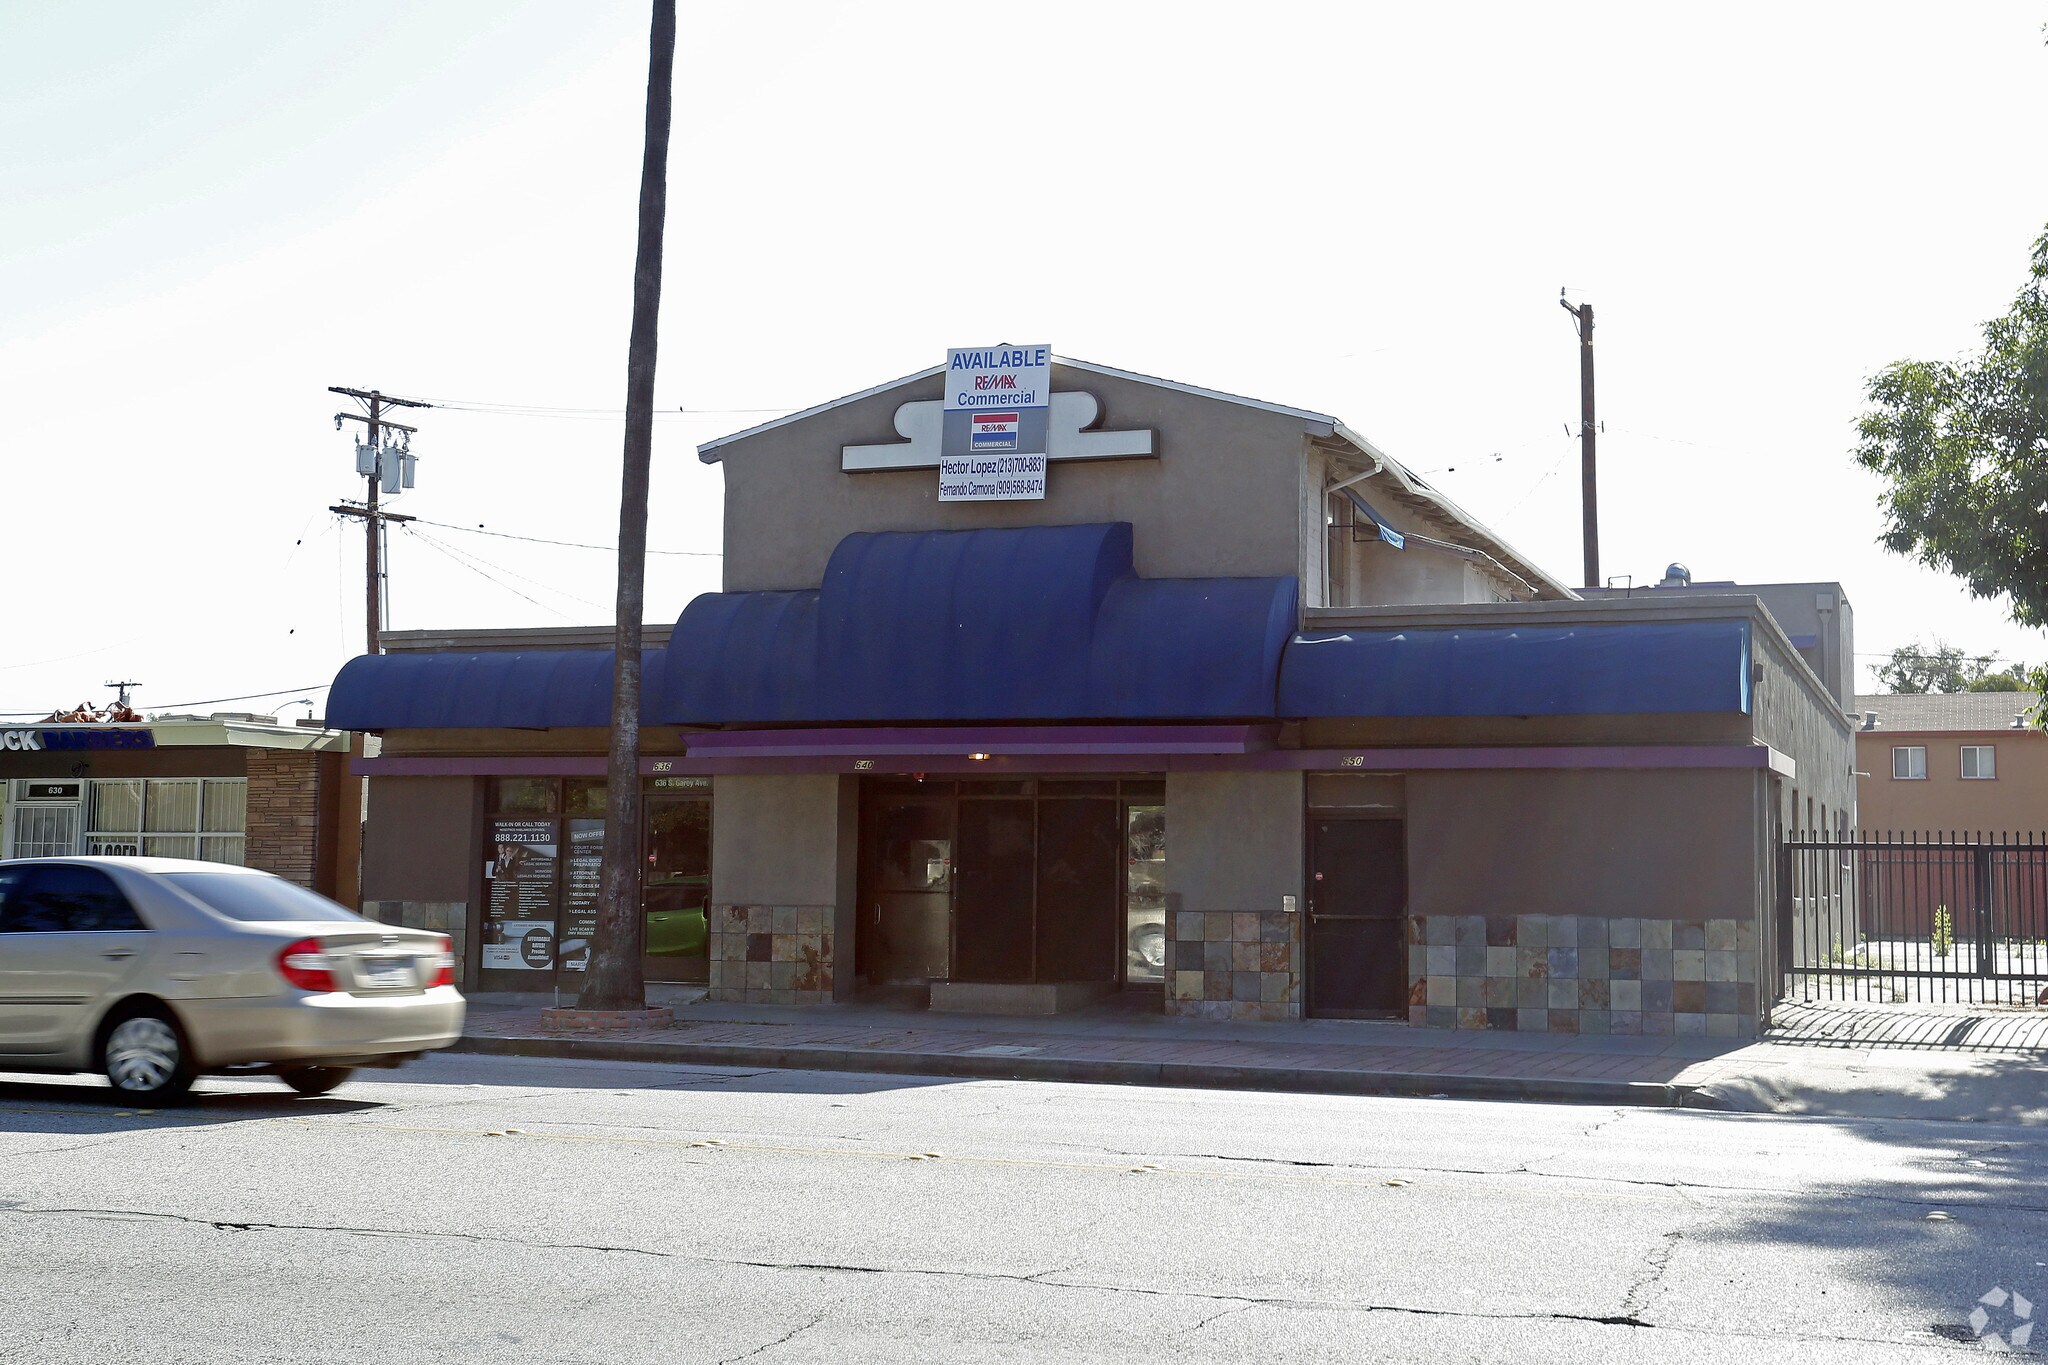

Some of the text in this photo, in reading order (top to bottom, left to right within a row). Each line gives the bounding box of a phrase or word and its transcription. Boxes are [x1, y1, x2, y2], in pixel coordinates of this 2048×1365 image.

[951, 349, 1046, 370] AVAILABLE
[975, 374, 1017, 390] RE/MAX
[958, 390, 1035, 406] Commercial
[981, 424, 1008, 432] RE/MAX
[941, 459, 969, 475] Hector
[970, 458, 997, 478] Lopez
[940, 479, 1043, 498] Fernando Carmona (909)568-8474
[42, 730, 155, 750] BARBERS
[654, 762, 671, 770] 636
[855, 761, 874, 769] 640
[655, 779, 667, 787] 636
[48, 786, 63, 794] 630
[495, 833, 551, 842] 888.221.1130
